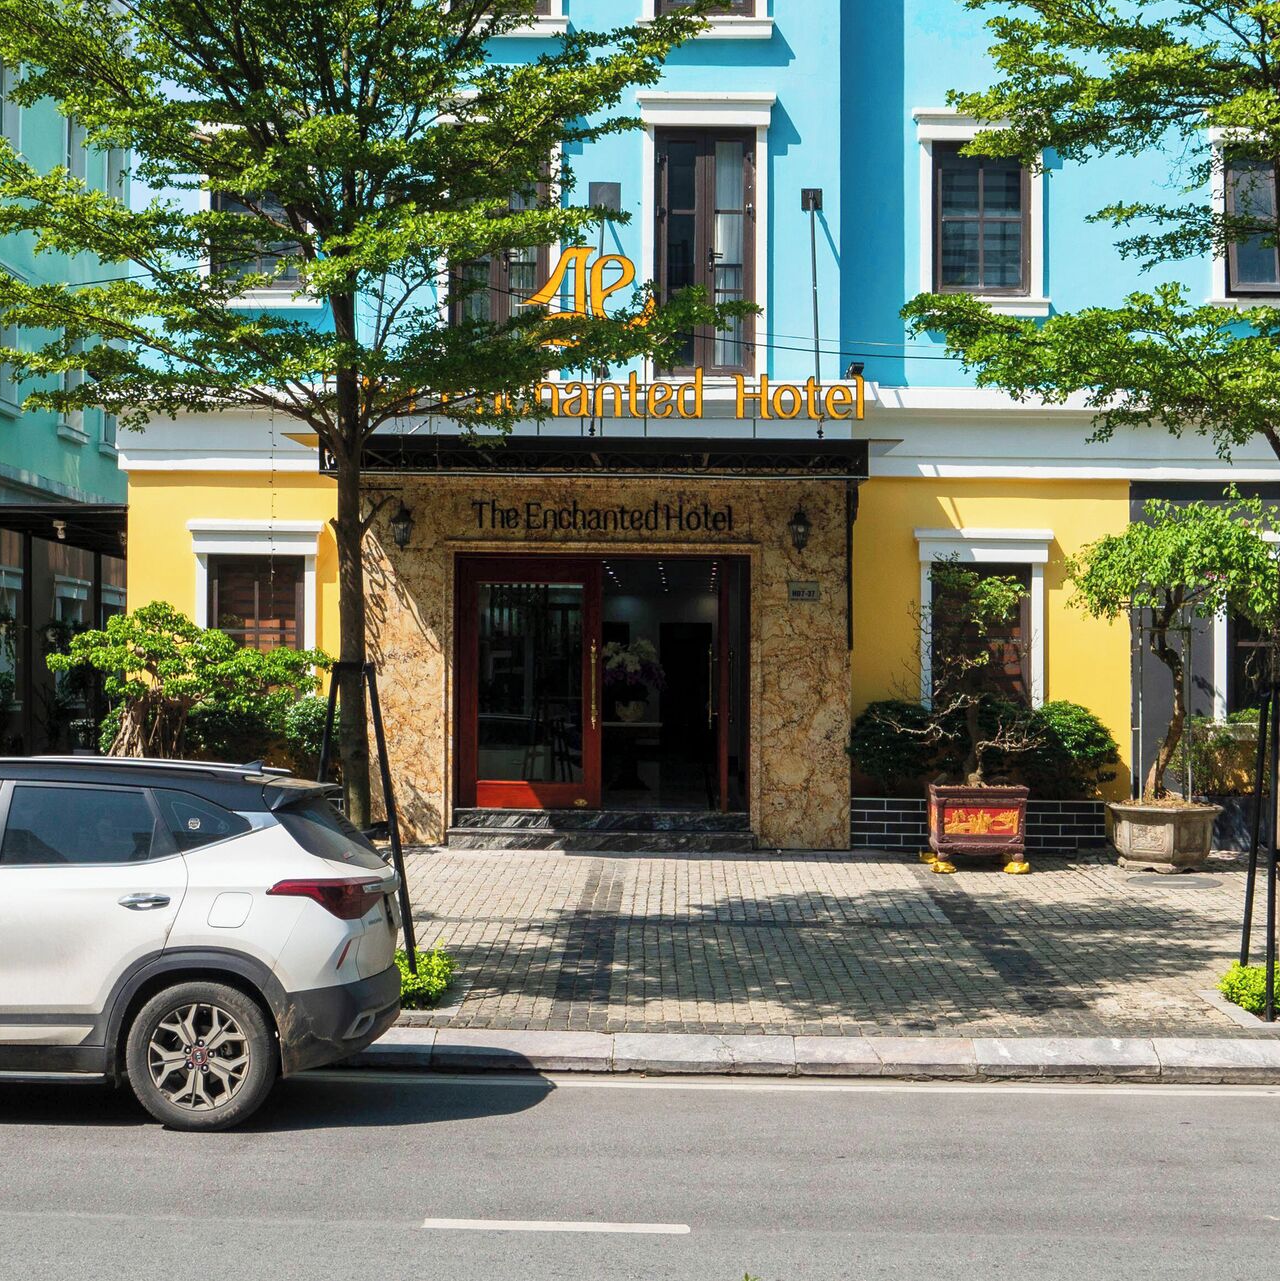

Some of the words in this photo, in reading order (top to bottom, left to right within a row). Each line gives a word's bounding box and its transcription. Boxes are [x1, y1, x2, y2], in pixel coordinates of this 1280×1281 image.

[731, 373, 865, 420] Hotel
[472, 501, 519, 529] The
[525, 500, 658, 531] Enchanted
[663, 502, 733, 531] Hotel
